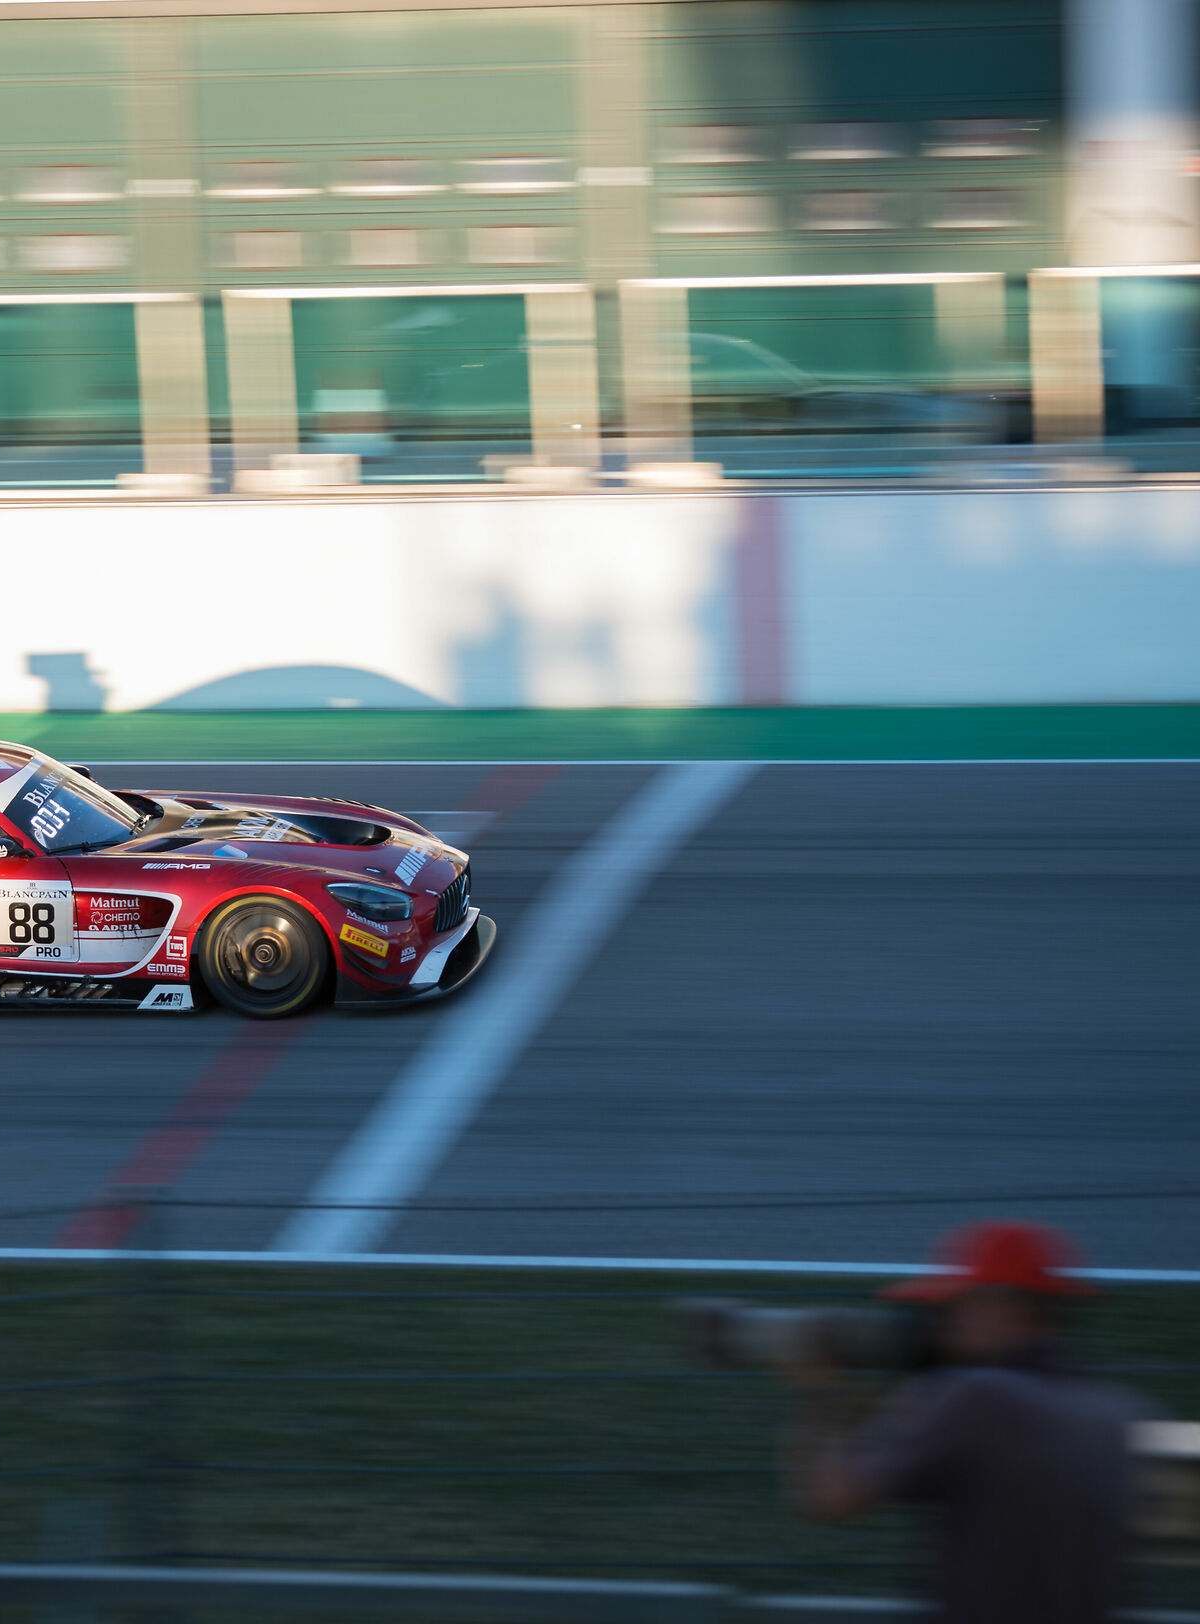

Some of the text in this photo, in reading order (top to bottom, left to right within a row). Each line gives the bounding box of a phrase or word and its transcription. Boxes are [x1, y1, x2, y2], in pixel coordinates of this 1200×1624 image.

[90, 896, 140, 908] Matmut
[8, 902, 55, 944] 88
[104, 912, 140, 922] CHEMO
[346, 908, 388, 934] Matmut
[346, 928, 384, 952] PIRELLI
[36, 947, 61, 957] PRO
